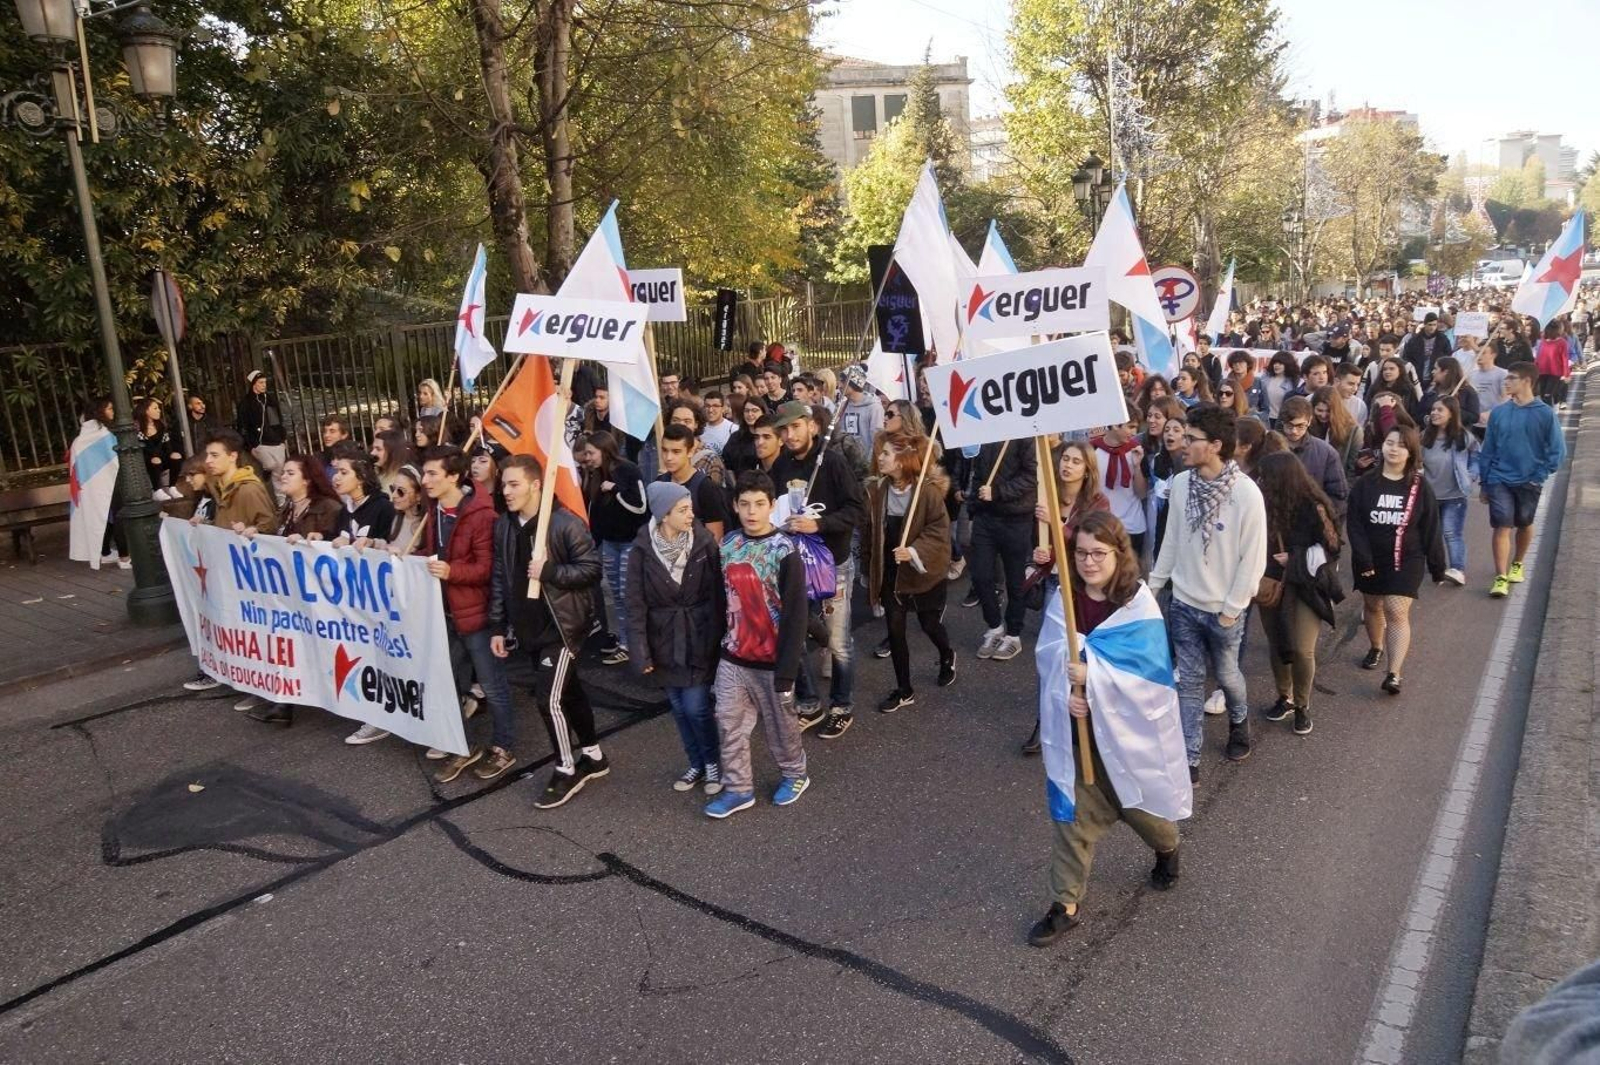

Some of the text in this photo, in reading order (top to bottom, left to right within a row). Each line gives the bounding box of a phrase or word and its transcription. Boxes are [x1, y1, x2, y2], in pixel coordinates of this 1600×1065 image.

[631, 280, 677, 304] rguer
[995, 281, 1092, 322] erguer
[545, 313, 637, 343] erguer
[980, 353, 1100, 417] erguer
[1376, 494, 1404, 509] AWE
[228, 541, 290, 597] Nin
[240, 599, 267, 626] Nin
[271, 606, 313, 635] pacto
[316, 618, 370, 644] entre
[213, 624, 262, 661] UNHA
[267, 633, 295, 668] LEI
[231, 665, 302, 697] EDUCACIÓN!
[361, 665, 425, 721] erguer
